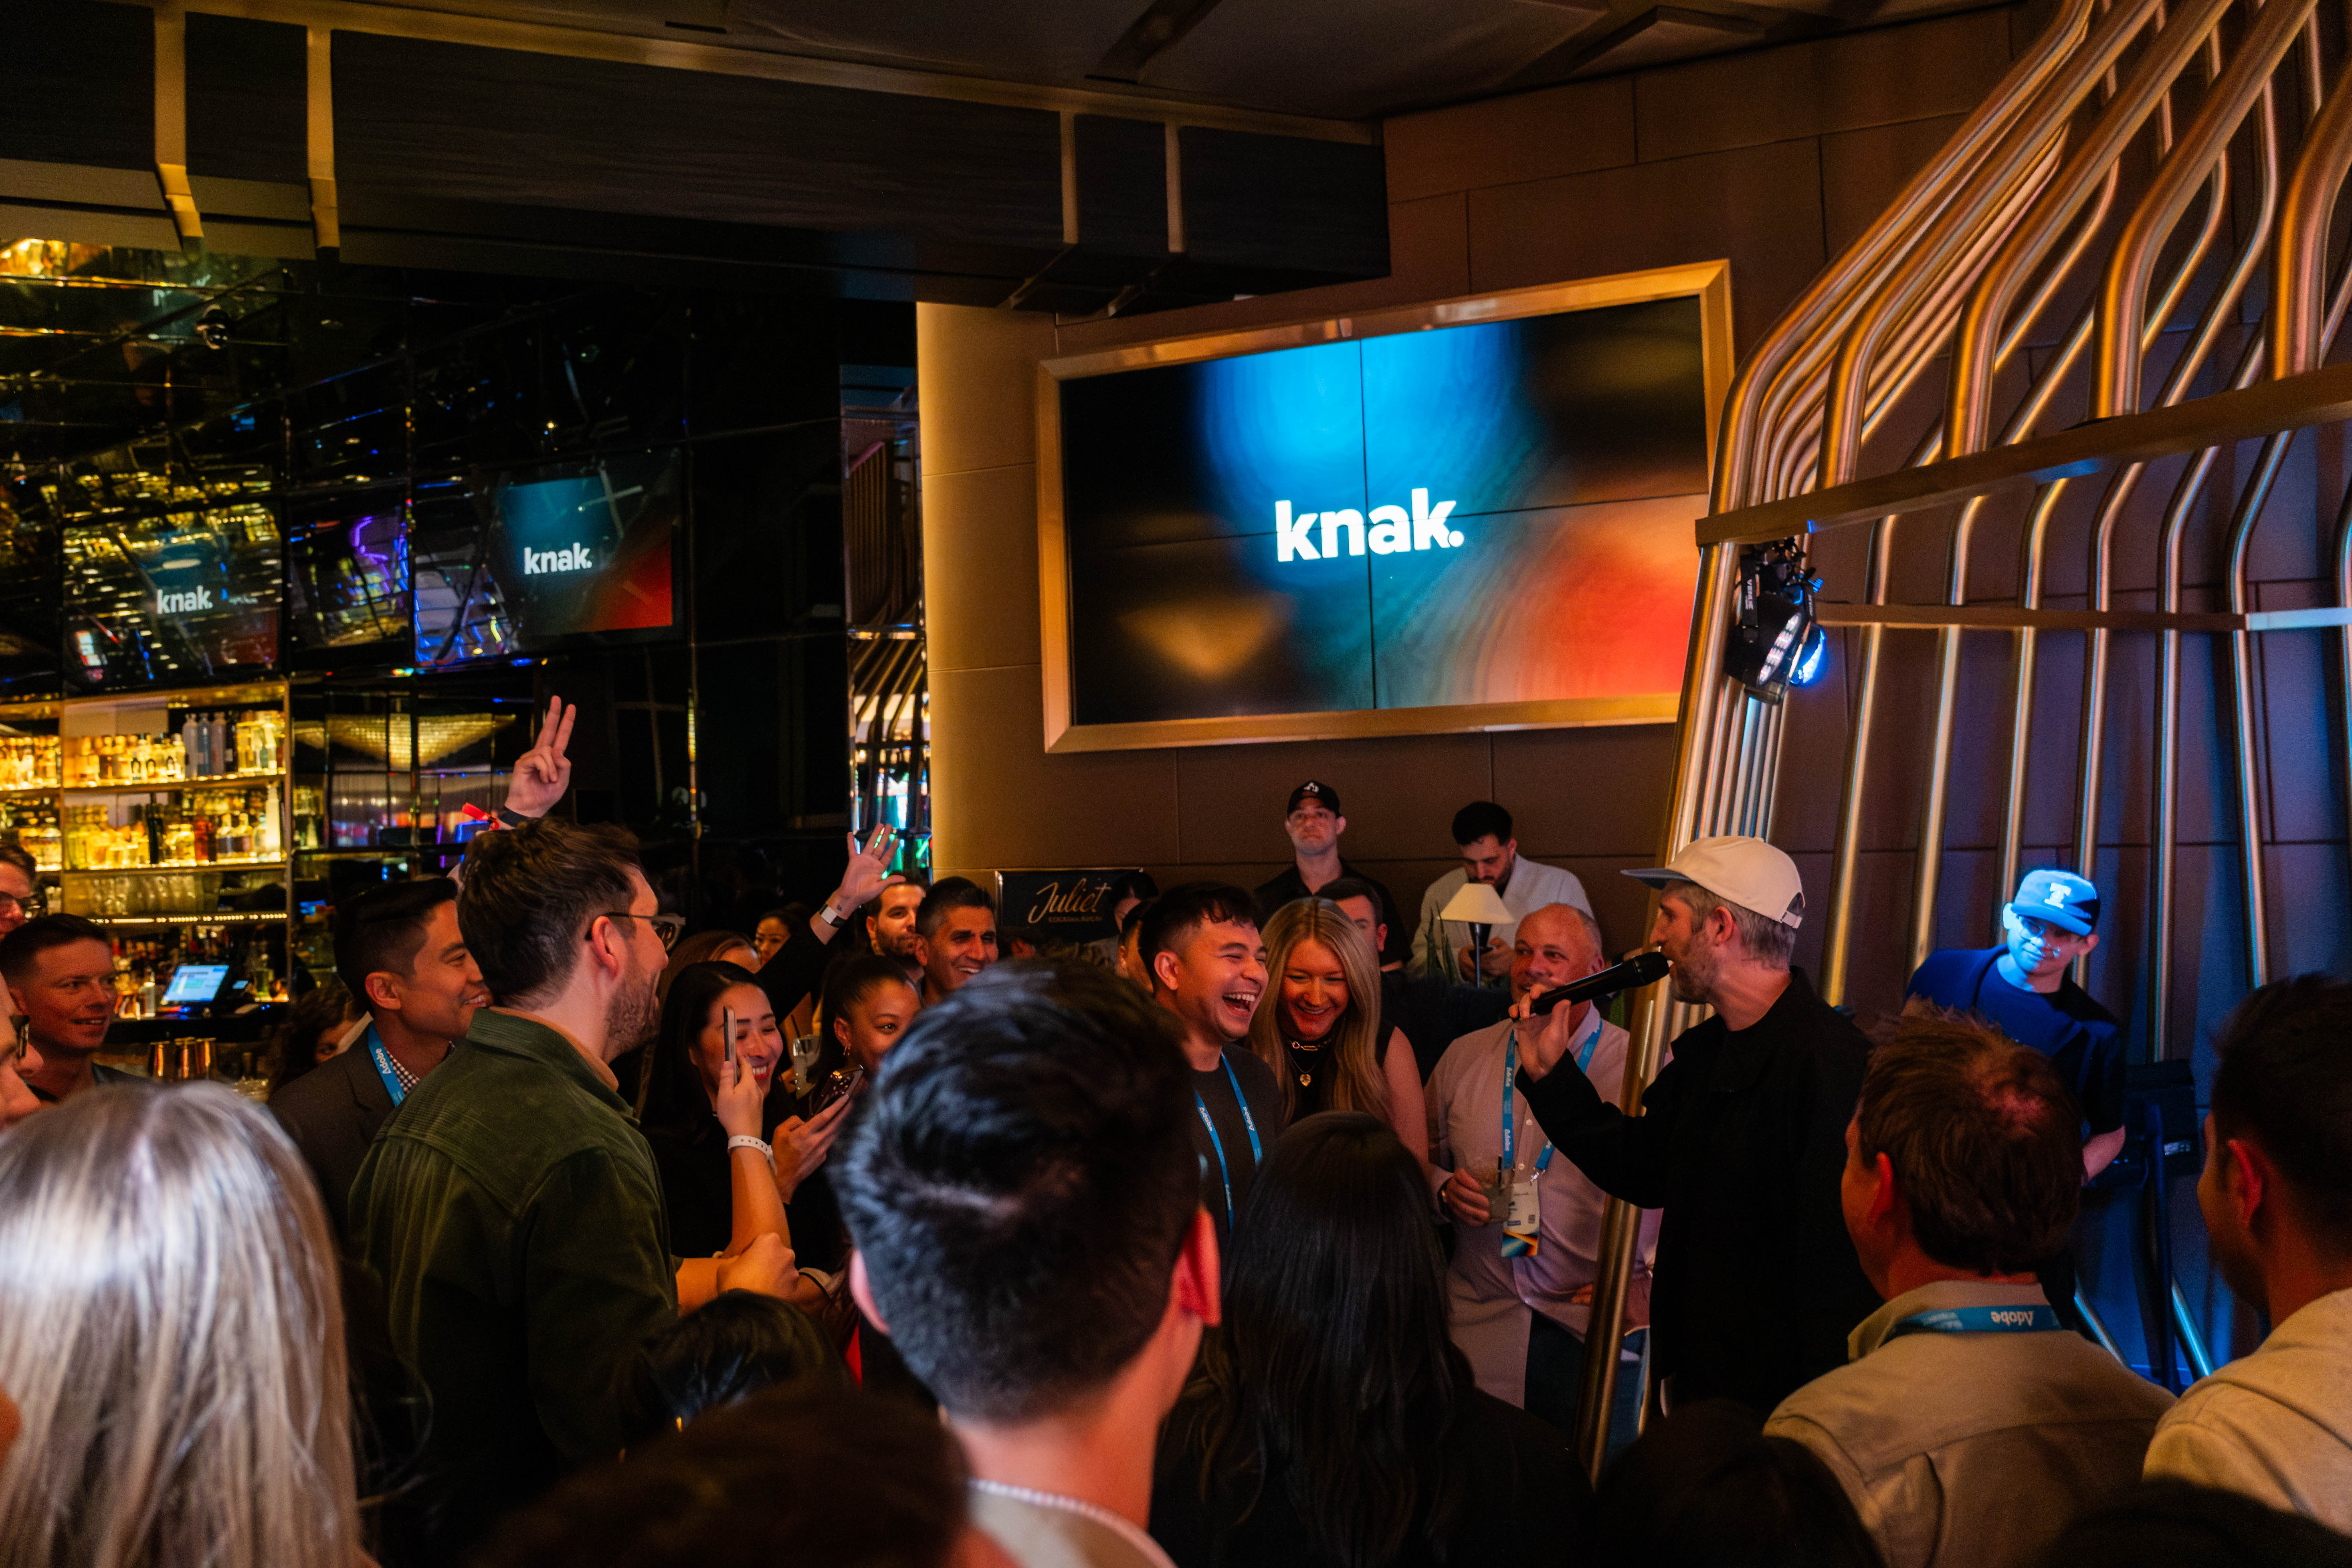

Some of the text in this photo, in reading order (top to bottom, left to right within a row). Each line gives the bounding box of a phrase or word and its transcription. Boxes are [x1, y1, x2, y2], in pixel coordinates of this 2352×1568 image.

[1275, 487, 1464, 562] knak.
[524, 542, 593, 574] knak.
[157, 585, 213, 614] knak.
[1028, 877, 1111, 923] Juliet
[376, 1048, 392, 1074] Adobe
[1199, 1107, 1212, 1132] Adobe
[1243, 1106, 1255, 1132] Adobe
[1990, 1310, 2034, 1326] Adobe
